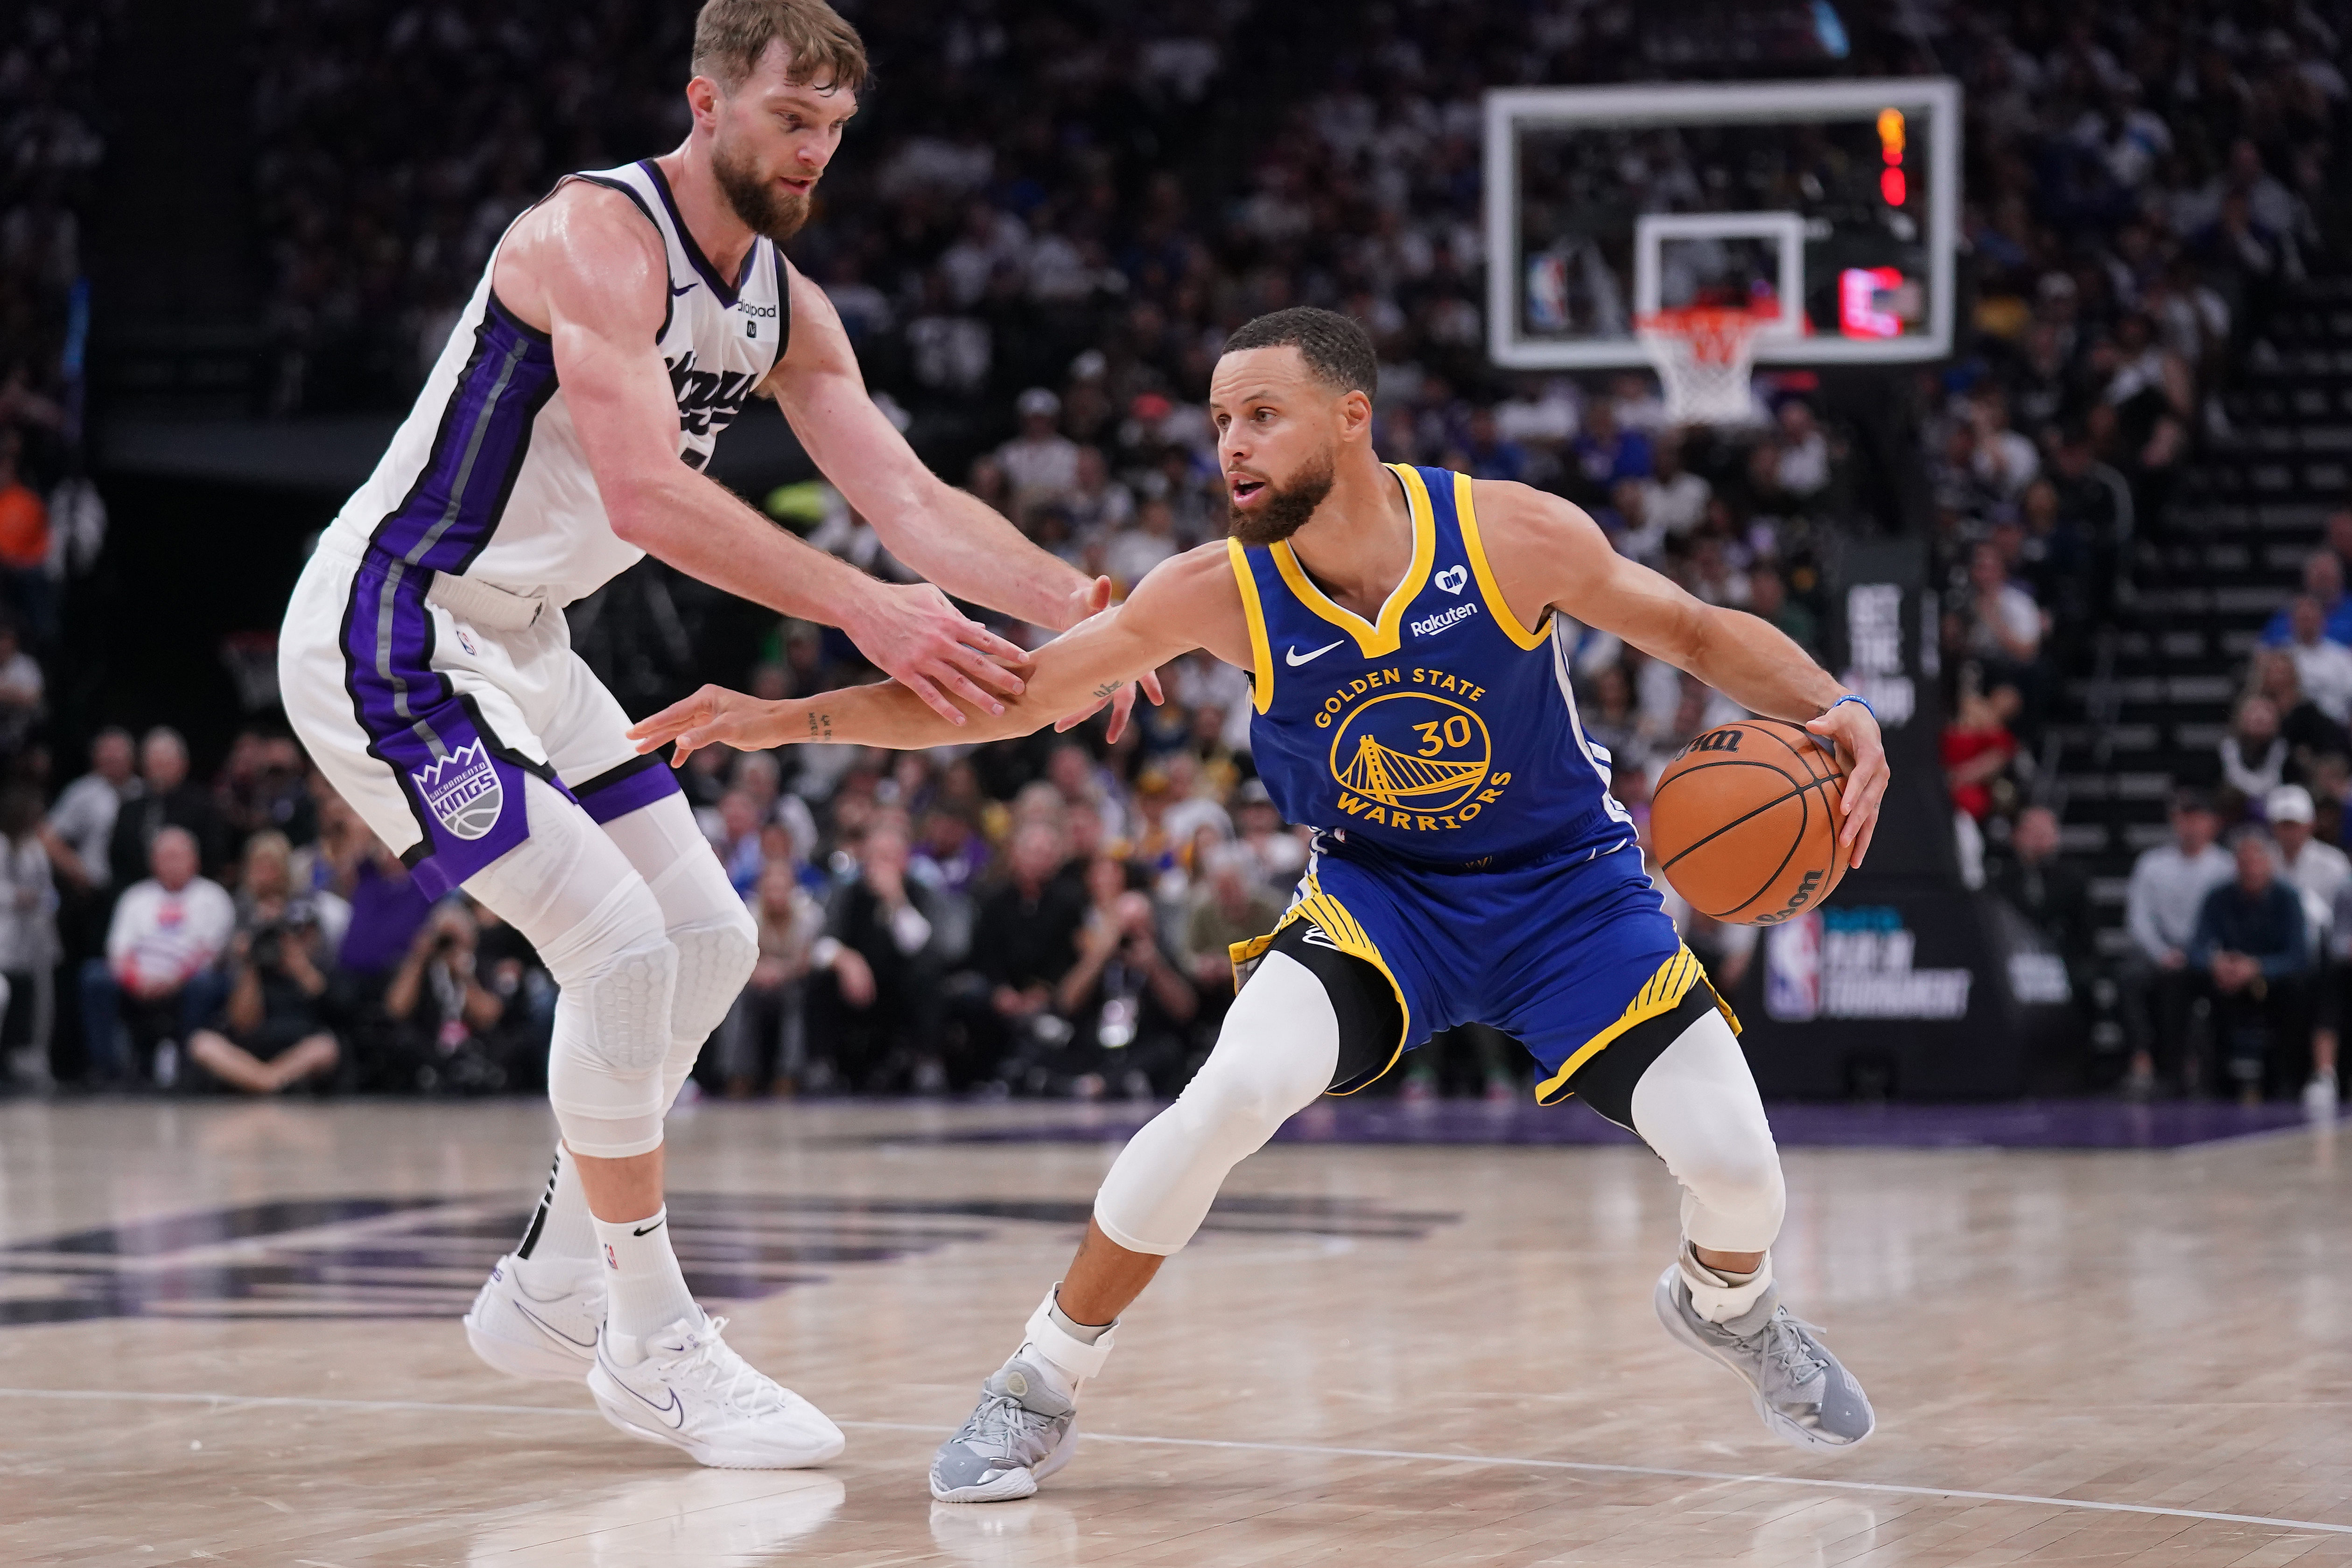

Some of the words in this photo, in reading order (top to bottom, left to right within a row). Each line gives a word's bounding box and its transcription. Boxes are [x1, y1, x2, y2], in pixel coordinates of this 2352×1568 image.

[737, 299, 776, 318] dialpad
[1443, 572, 1462, 589] DM
[1411, 603, 1478, 637] Rakuten
[1314, 668, 1400, 728] GOLDEN
[1412, 668, 1486, 702] STATE
[1412, 715, 1472, 757] 30
[430, 762, 487, 801] SACRAMENTO
[434, 772, 498, 819] KINGS
[1337, 771, 1511, 831] WARRIORS
